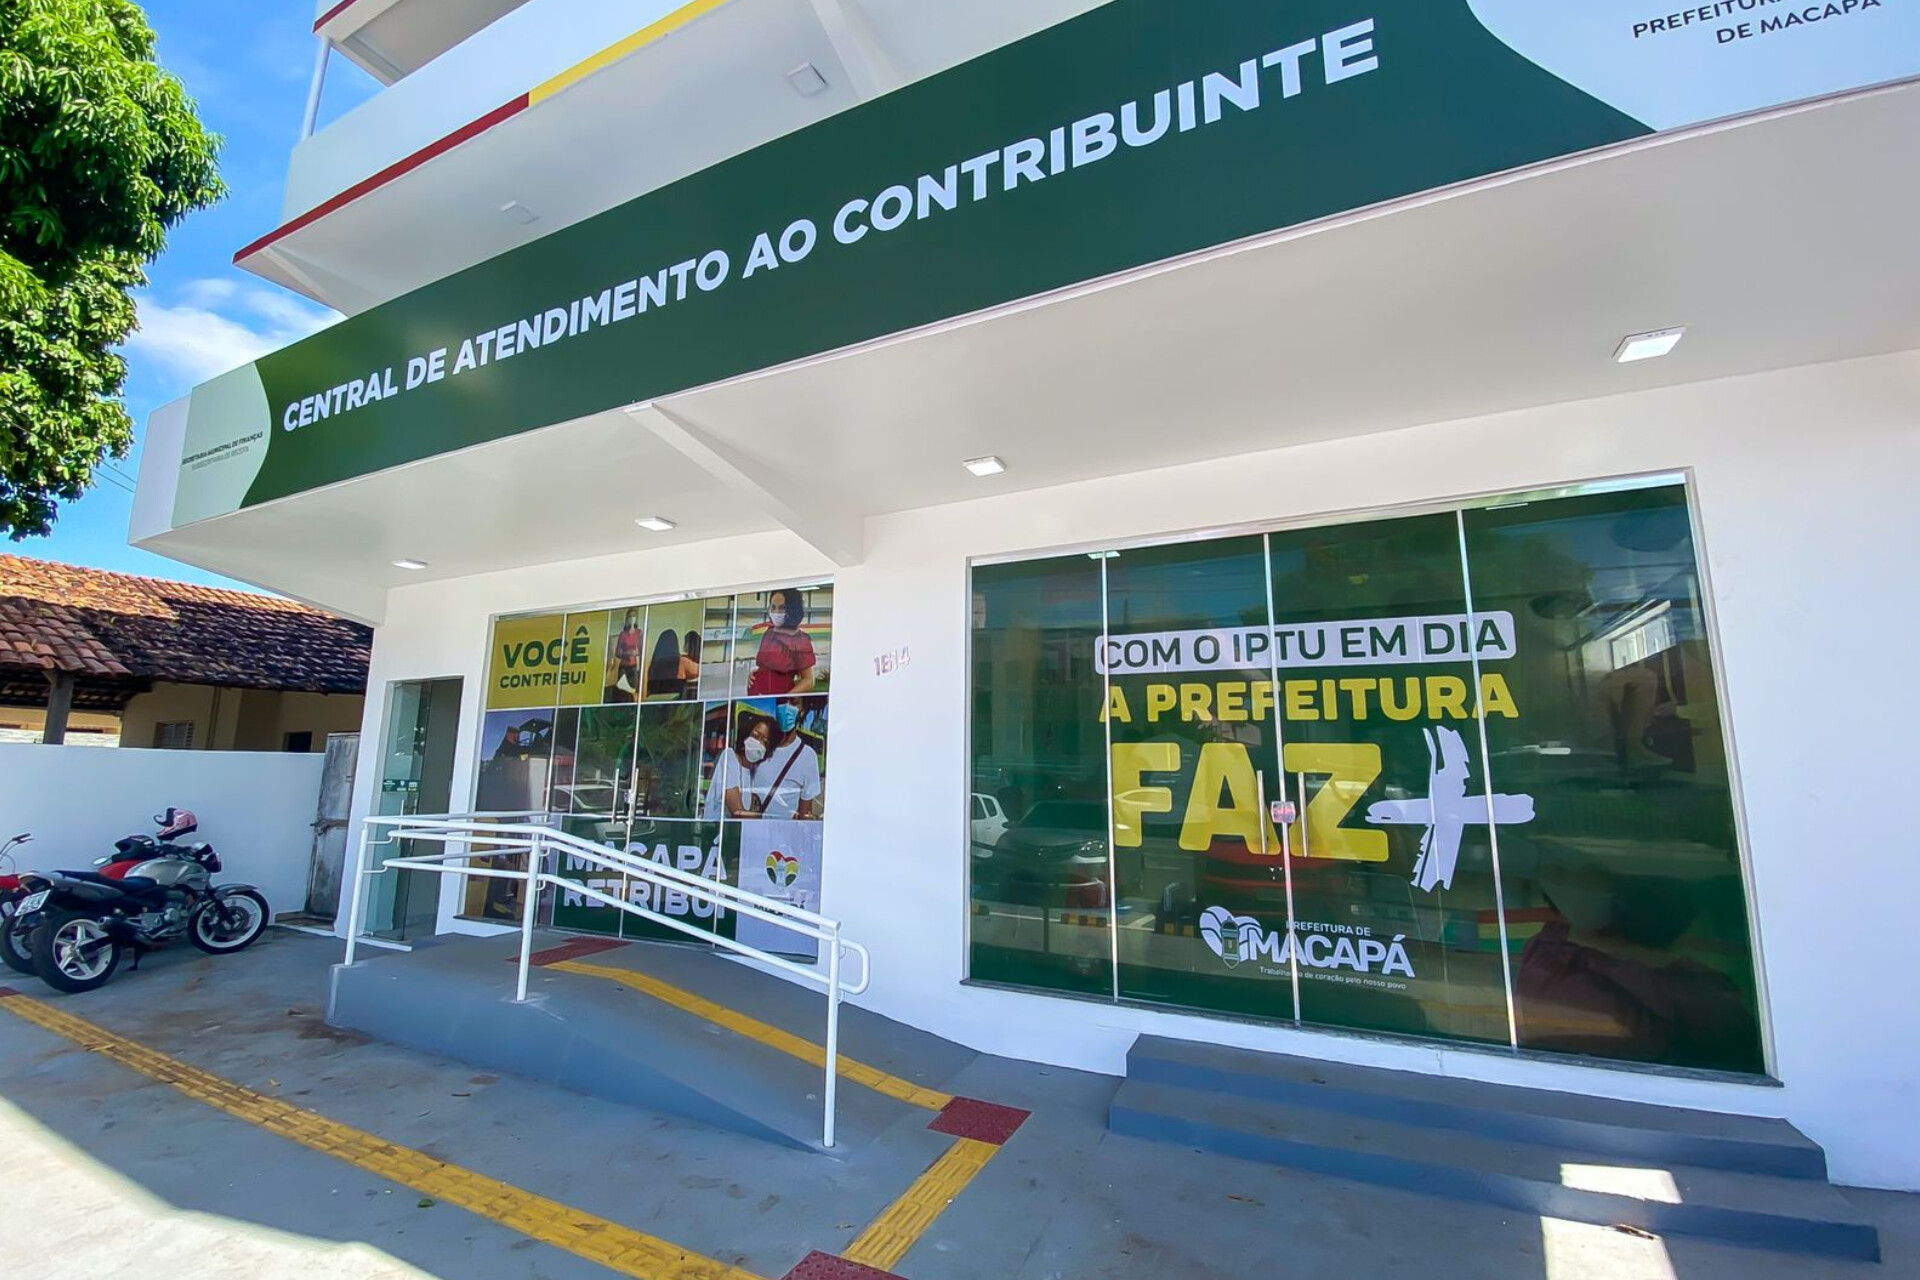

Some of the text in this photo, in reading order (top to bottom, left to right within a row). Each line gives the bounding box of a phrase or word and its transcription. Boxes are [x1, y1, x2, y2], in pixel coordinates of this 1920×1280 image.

[1632, 0, 1782, 38] PREFEITU
[1716, 23, 1753, 44] DE
[283, 18, 1378, 431] CENTRAL DE ATENDIMENTO AO CONTRIBUINTE
[503, 625, 590, 668] VOCÊ
[1101, 619, 1507, 669] COM O IPTU EM DIA
[500, 671, 586, 689] CONTRIBUI
[1099, 673, 1519, 722] A PREFEITURA
[1111, 742, 1389, 862] FAZ
[564, 878, 725, 919] RETRIBUI
[1356, 926, 1371, 936] DE
[1250, 931, 1415, 978] MACAPÁ
[1260, 966, 1407, 991] Trabalhao de coração pelo nosso povo
